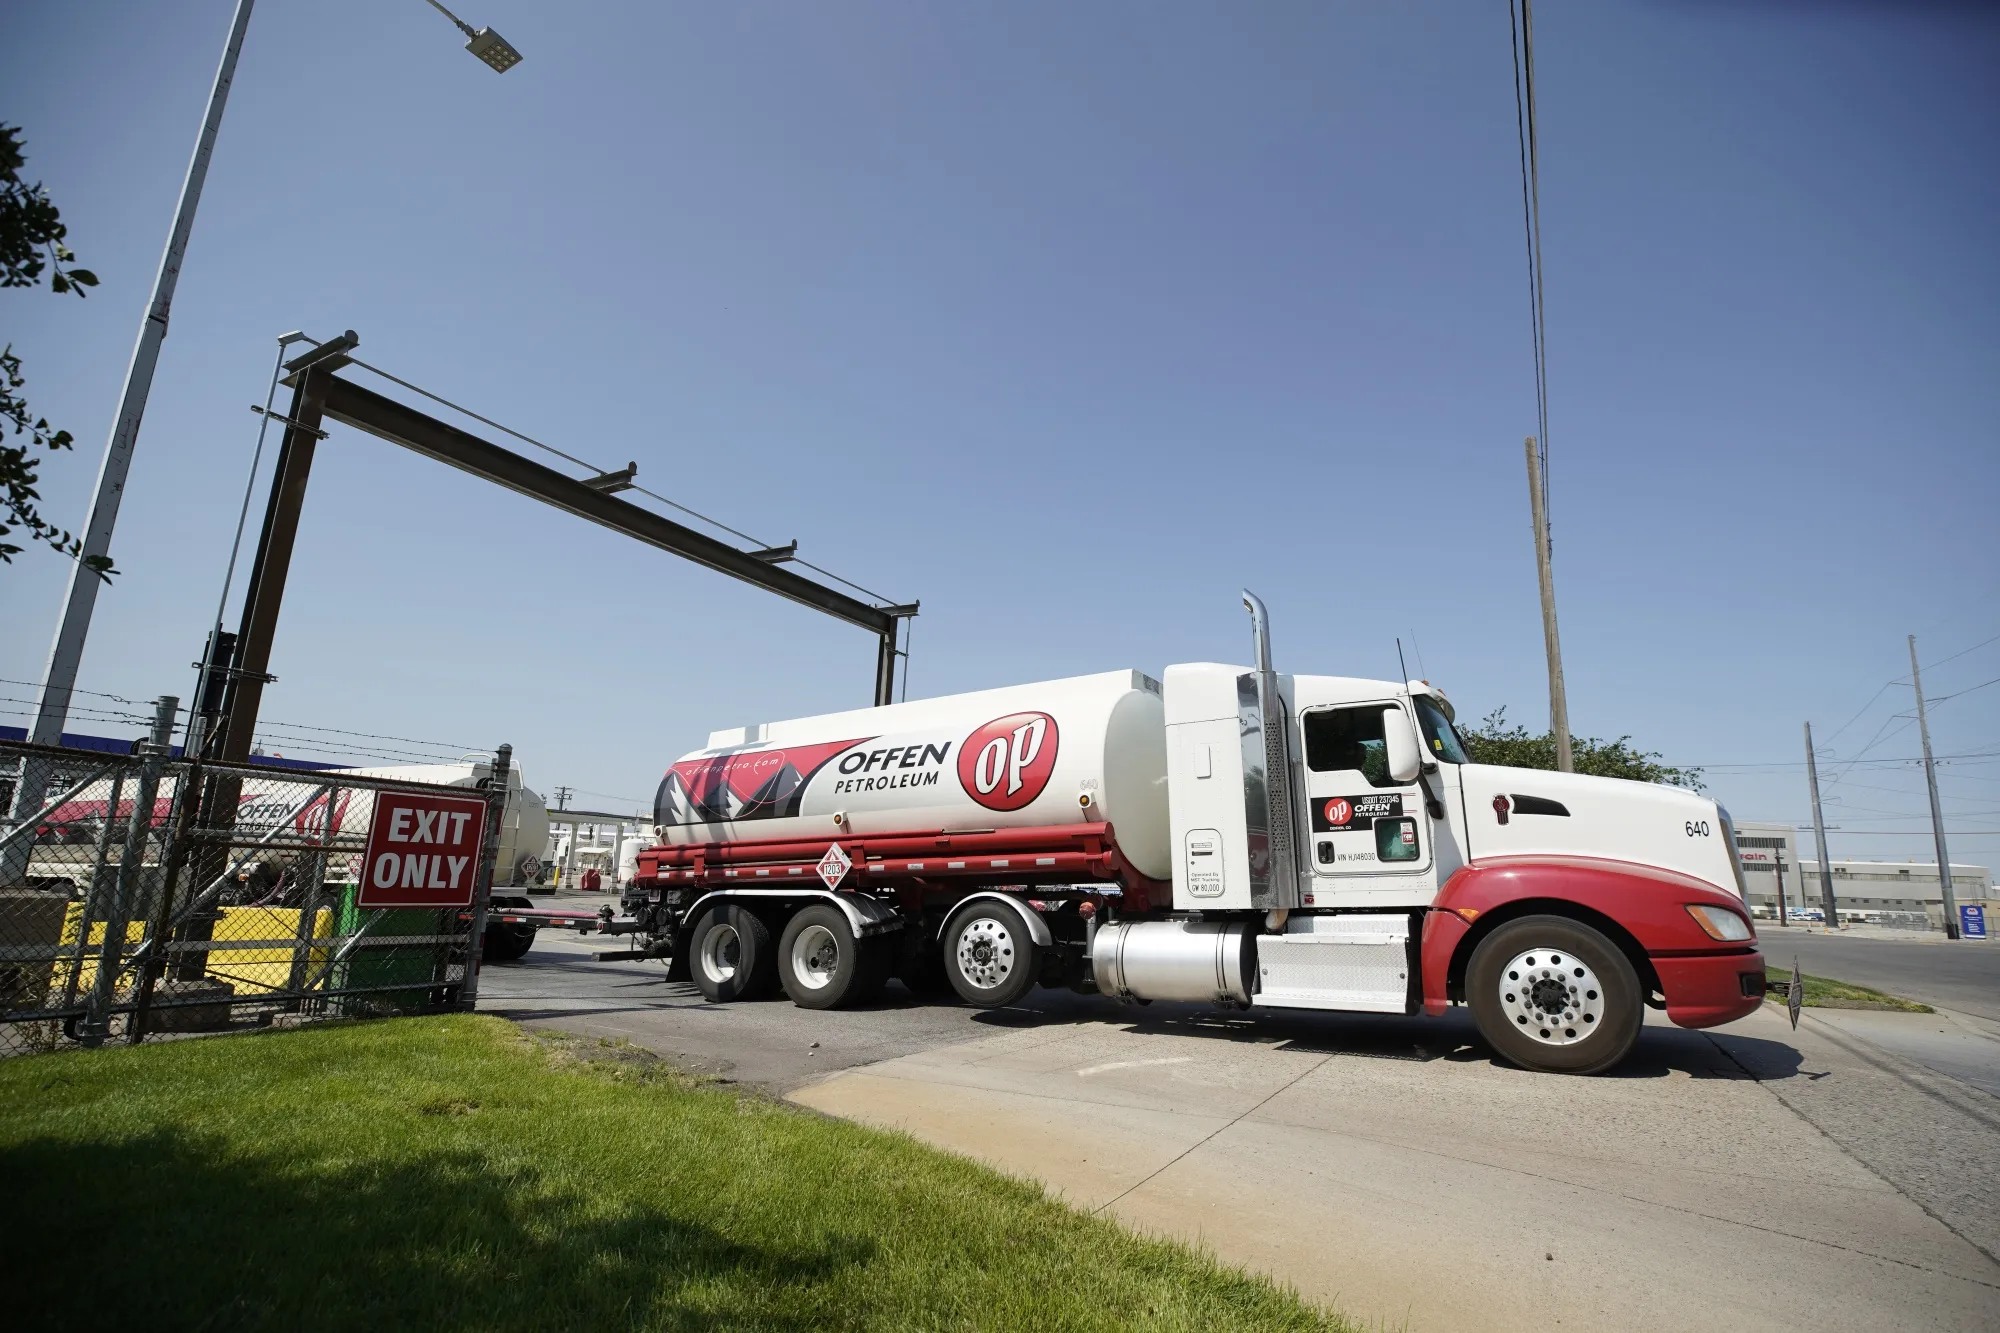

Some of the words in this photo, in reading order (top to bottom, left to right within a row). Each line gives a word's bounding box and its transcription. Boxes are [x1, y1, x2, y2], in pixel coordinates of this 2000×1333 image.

[838, 741, 952, 775] OFFEN
[974, 717, 1048, 798] OP
[686, 758, 778, 776] offenpetro.com
[835, 771, 940, 794] PETROLEUM
[1354, 803, 1390, 812] OFFEN
[1361, 796, 1378, 805] USDOT
[236, 803, 299, 819] OFFEN
[387, 807, 472, 845] EXIT
[1685, 821, 1710, 837] 640
[1337, 853, 1347, 861] VIN
[373, 852, 470, 889] ONLY
[825, 864, 841, 875] 1203
